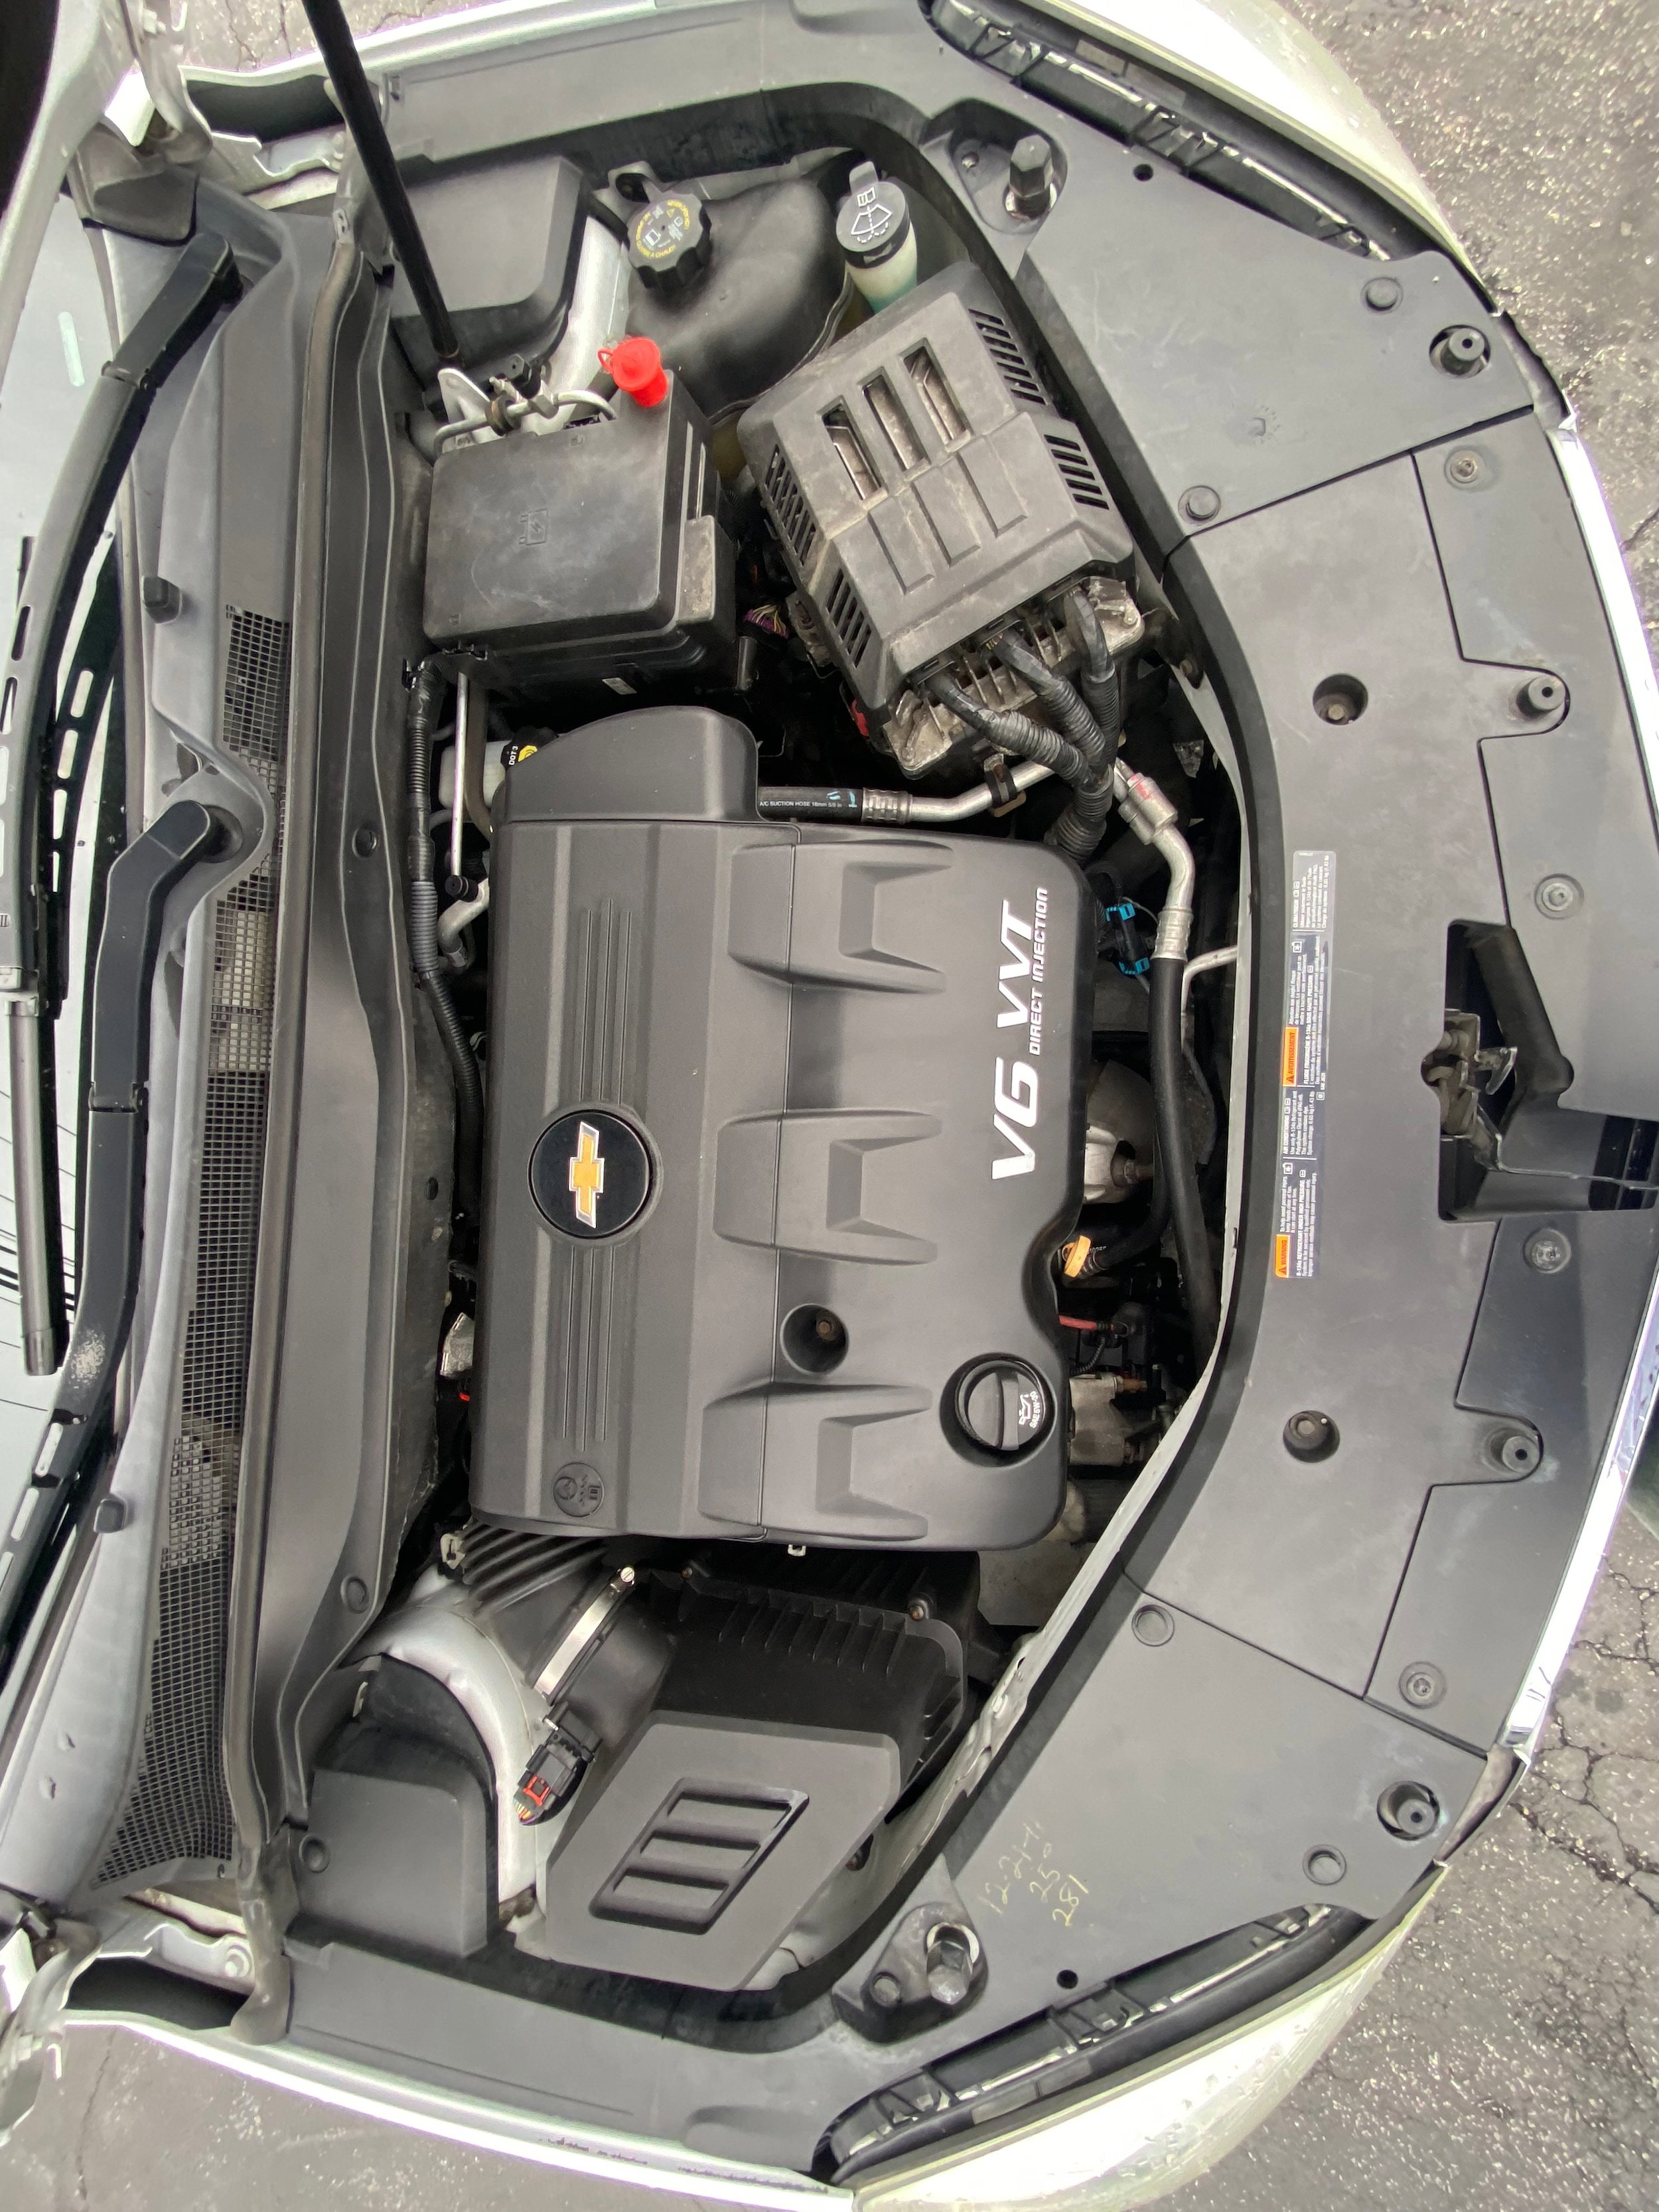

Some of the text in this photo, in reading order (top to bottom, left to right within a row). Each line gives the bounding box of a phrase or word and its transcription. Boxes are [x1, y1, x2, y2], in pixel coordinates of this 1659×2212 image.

[508, 751, 517, 766] DOT
[1028, 887, 1048, 1056] DIRECT INJECTION
[991, 899, 1038, 1180] V6 VVT
[1029, 1390, 1041, 1429] SAE 5W-30
